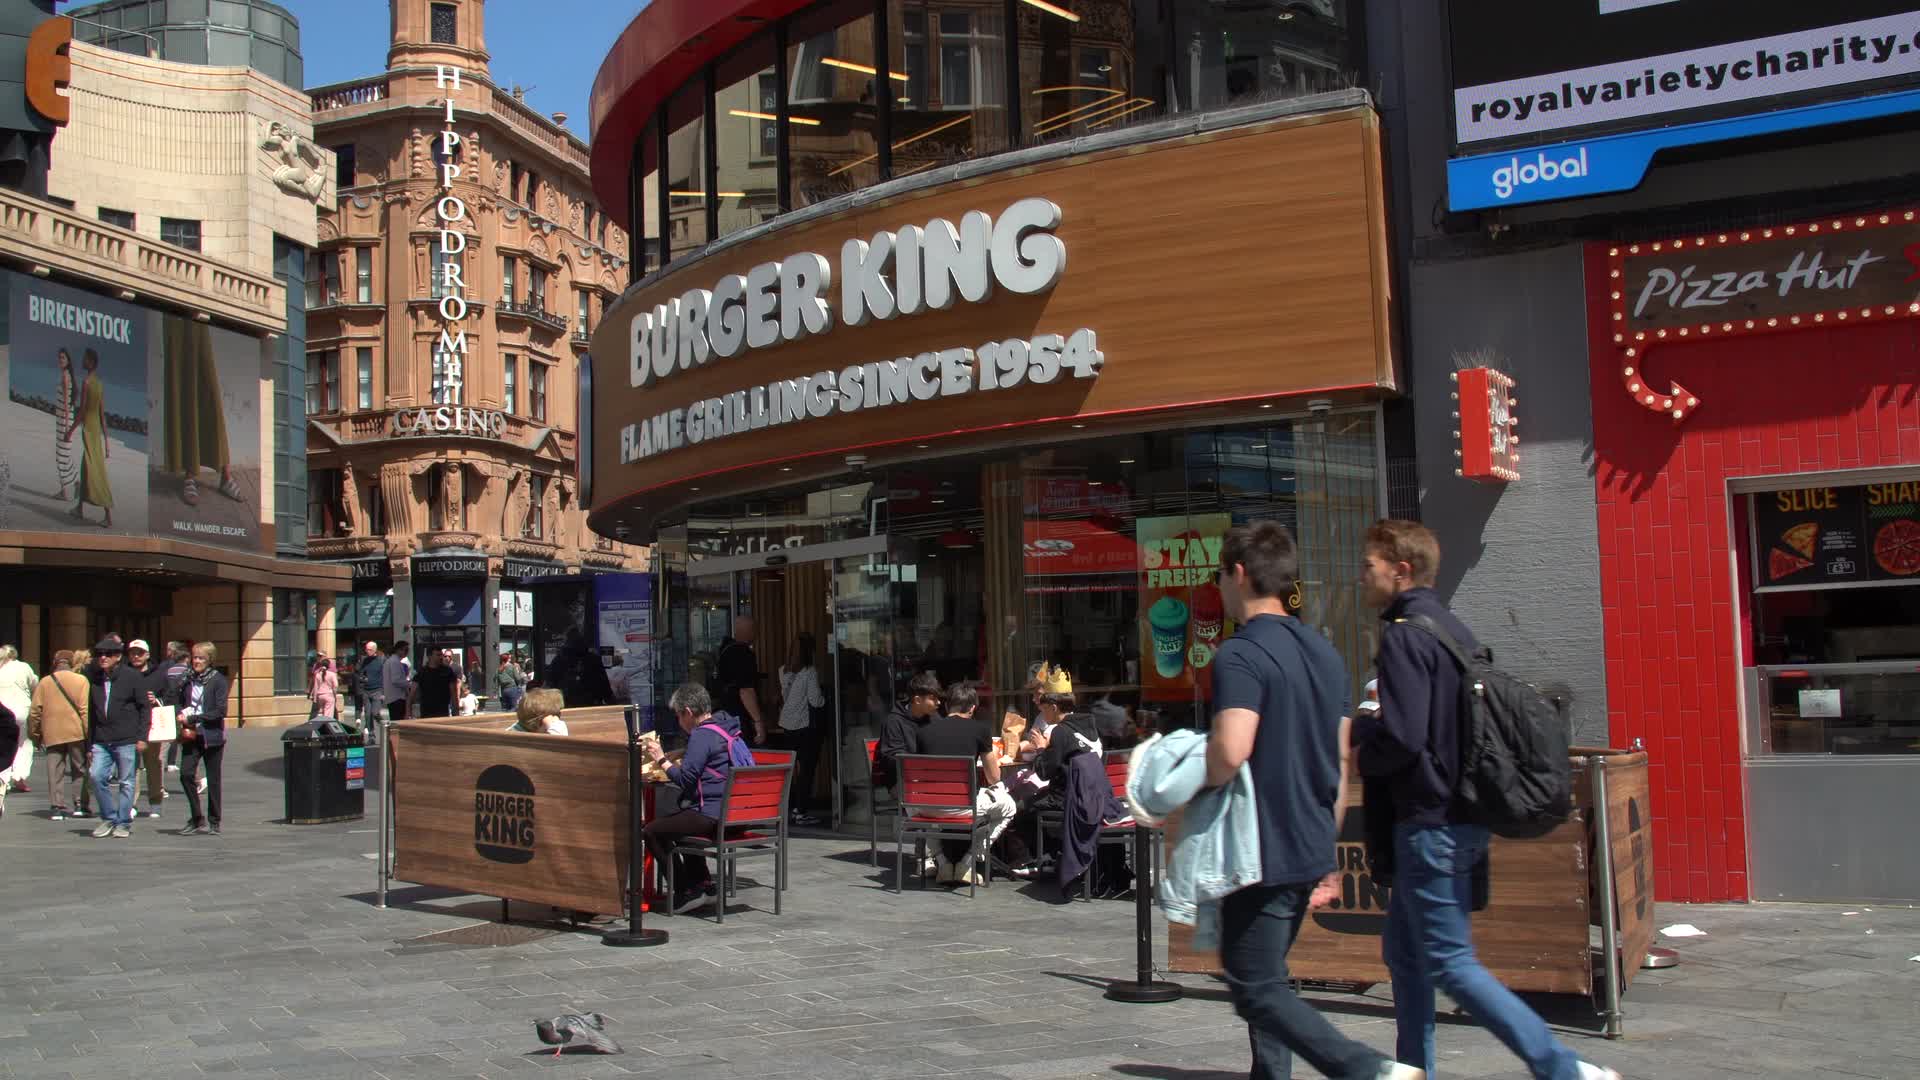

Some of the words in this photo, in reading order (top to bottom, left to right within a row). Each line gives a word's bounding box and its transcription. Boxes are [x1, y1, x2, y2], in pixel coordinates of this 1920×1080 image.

[1492, 148, 1588, 199] global
[436, 65, 469, 387] HIPPODROME
[629, 252, 833, 388] BURGER
[840, 197, 1067, 326] KING
[1634, 265, 1768, 318] Pizza
[1776, 249, 1886, 297] Hut
[29, 294, 130, 345] BIRKENSTOCK
[620, 408, 686, 465] FLAME
[686, 371, 838, 443] GRILLING
[837, 346, 974, 413] SINCE
[976, 328, 1105, 391] 1954
[392, 406, 508, 437] CASINO
[1777, 487, 1838, 512] SLICE
[173, 519, 193, 532] WALK.
[194, 522, 222, 536] WANDER.
[223, 526, 248, 538] ESCAPE.
[1144, 536, 1224, 568] STAY
[475, 792, 535, 818] BURGER
[475, 815, 535, 848] KING
